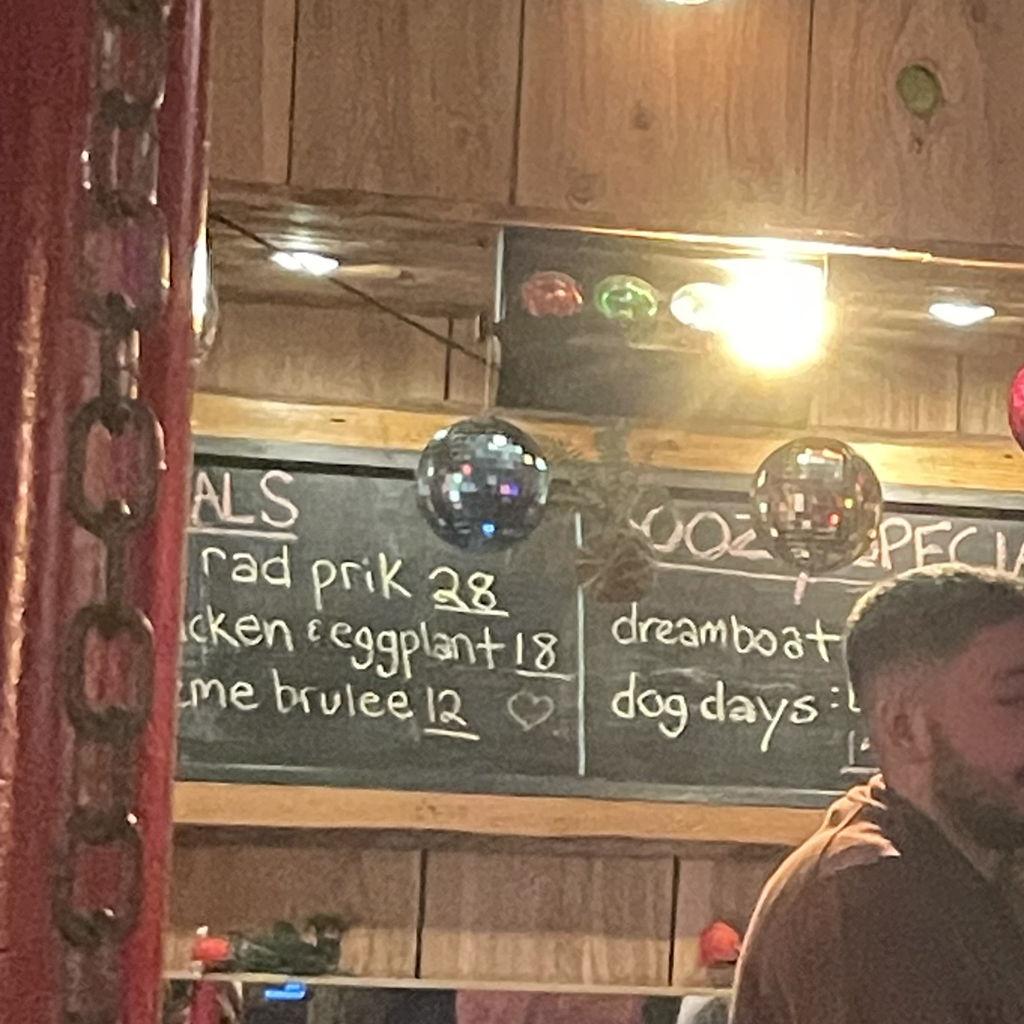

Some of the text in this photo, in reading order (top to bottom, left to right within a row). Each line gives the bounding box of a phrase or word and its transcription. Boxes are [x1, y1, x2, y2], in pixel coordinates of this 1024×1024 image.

[201, 544, 498, 611] rad prik 28
[329, 620, 506, 680] eggplant
[515, 631, 559, 671] 18
[611, 601, 841, 663] dreamboat
[271, 668, 413, 720] brulee
[427, 686, 468, 726] 12
[611, 671, 689, 738] dog
